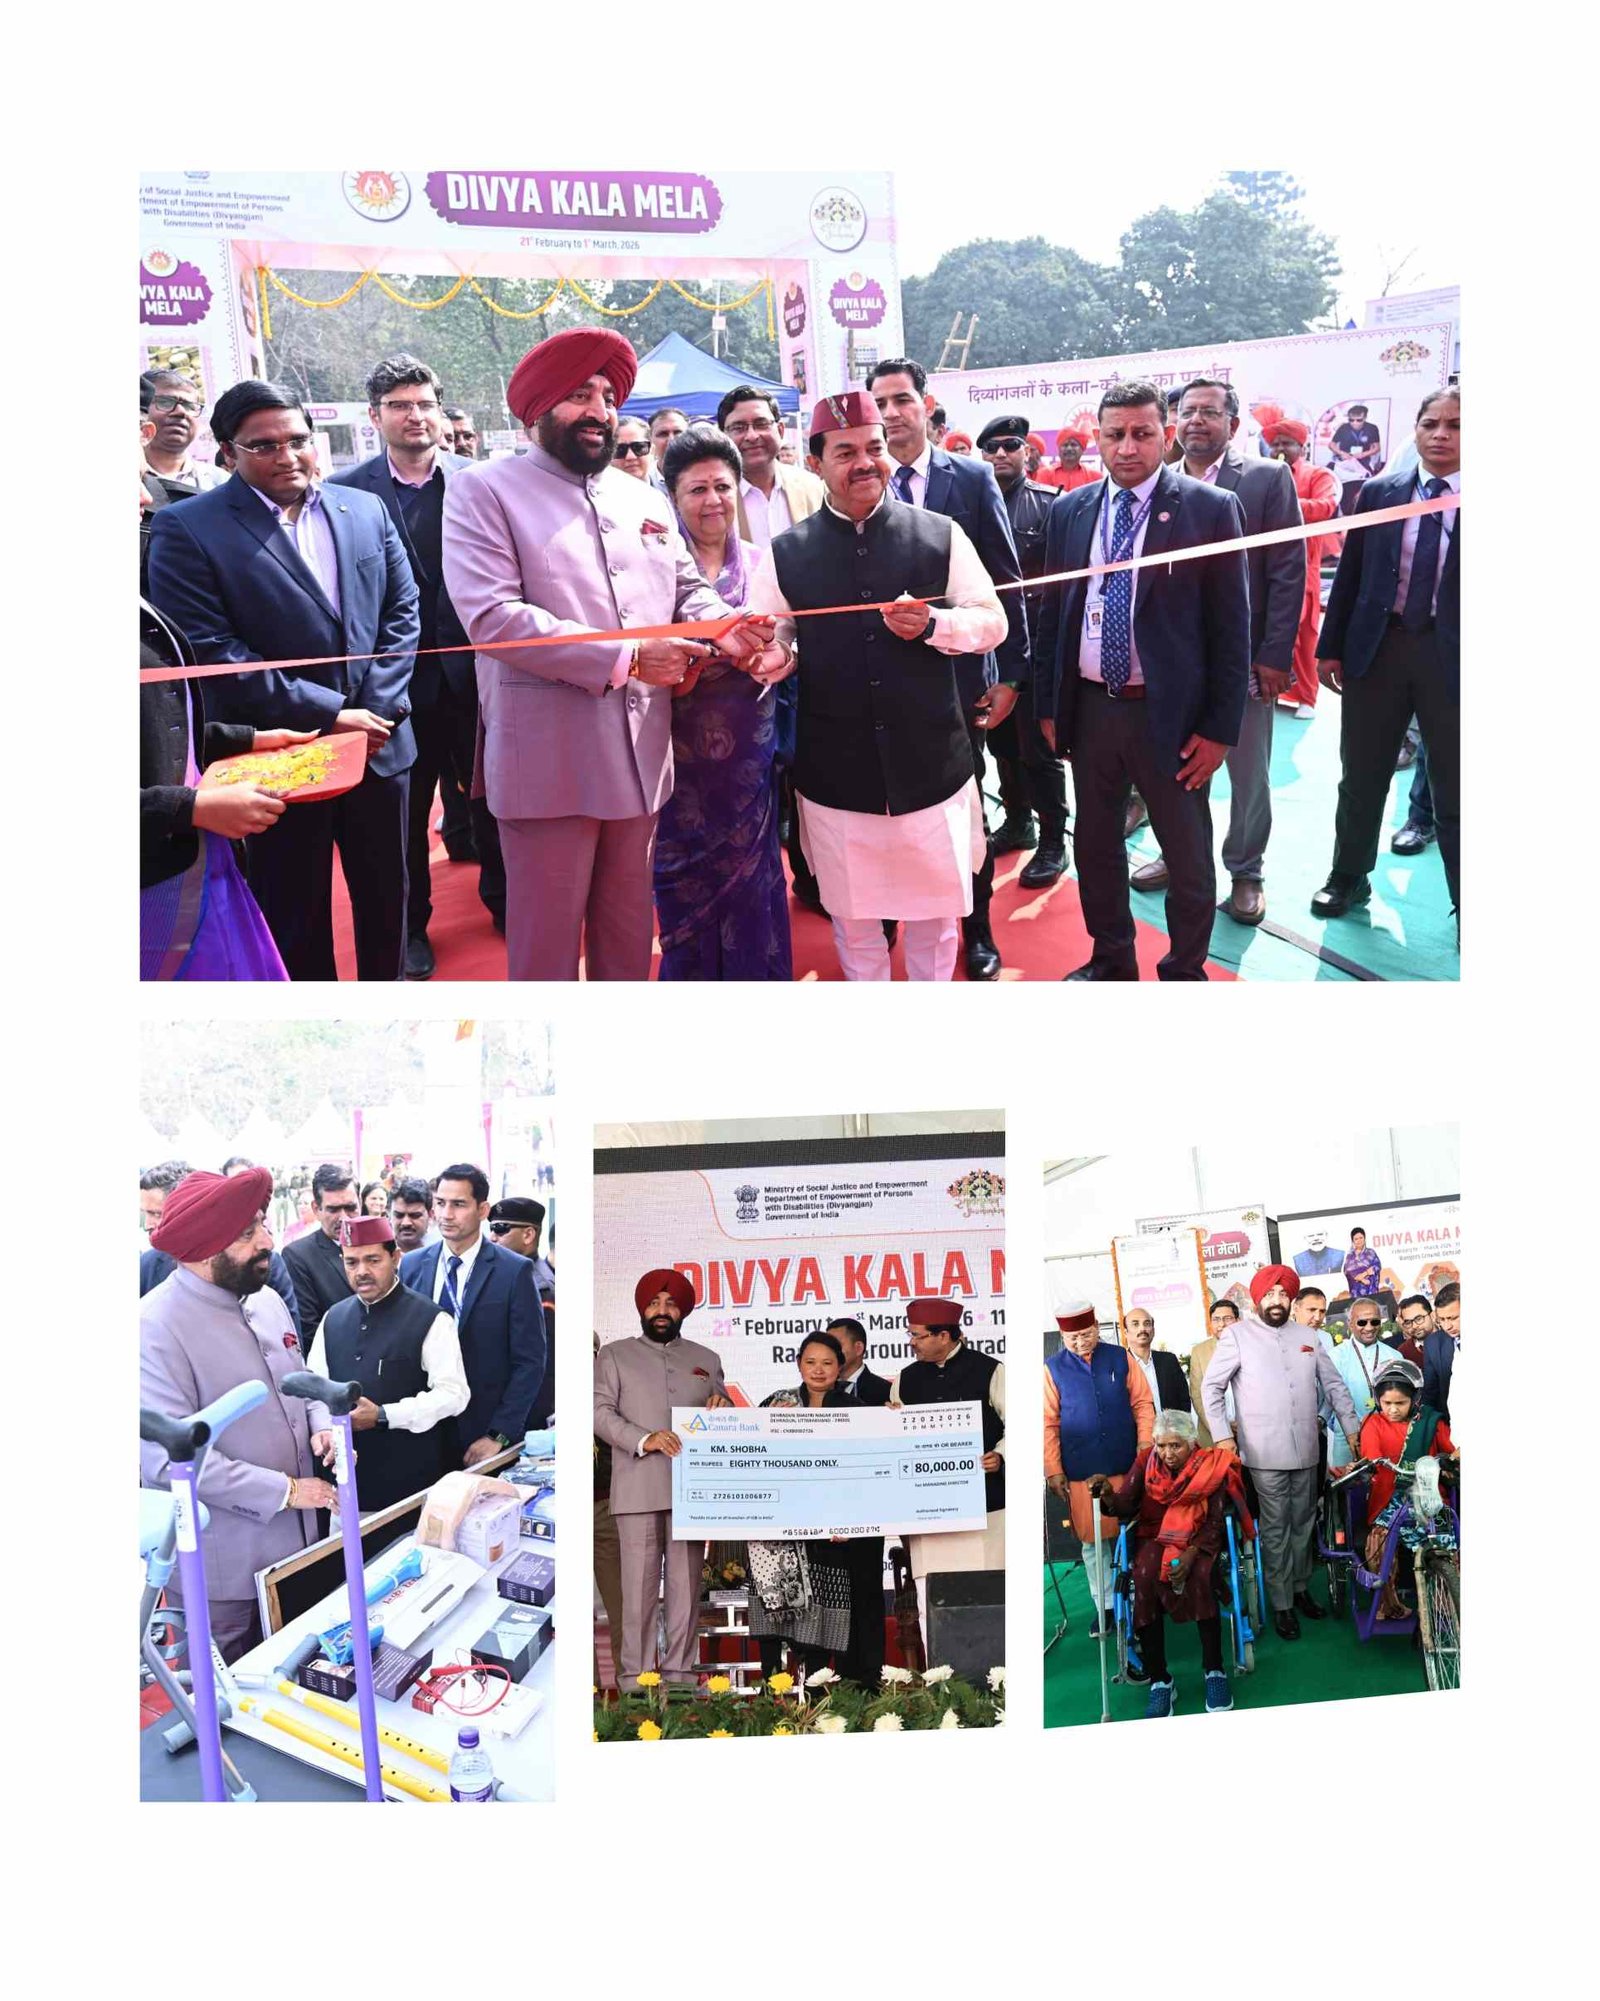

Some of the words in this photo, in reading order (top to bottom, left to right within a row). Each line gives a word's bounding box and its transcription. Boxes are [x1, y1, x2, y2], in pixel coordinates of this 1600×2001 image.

[156, 187, 181, 195] Social
[184, 189, 213, 198] Justice
[216, 191, 231, 199] and
[234, 192, 290, 202] Empowerment
[446, 173, 544, 214] DIVYA
[550, 179, 627, 217] KALA
[634, 184, 709, 219] MELA
[252, 203, 283, 212] Persons
[163, 219, 212, 229] Government
[226, 221, 246, 230] India
[535, 238, 572, 250] February
[574, 239, 582, 249] to
[621, 240, 640, 250] 2026
[169, 285, 205, 301] KALA
[145, 300, 182, 316] MELA
[833, 297, 859, 309] DIVYA
[861, 297, 882, 309] KALA
[845, 310, 868, 321] MELA
[968, 379, 1036, 404] दिव्यांगजनों
[1040, 379, 1053, 398] के
[1152, 373, 1176, 387] का
[764, 1185, 794, 1194] Ministry
[806, 1184, 828, 1192] Social
[831, 1182, 857, 1191] Justice
[875, 1180, 927, 1189] Empowerment
[765, 1194, 807, 1204] Department
[810, 1193, 817, 1201] of
[820, 1192, 872, 1201] Empowerment
[874, 1191, 881, 1199] of
[884, 1190, 913, 1198] Persons
[765, 1203, 781, 1211] with
[784, 1202, 824, 1211] Disabilities
[827, 1200, 873, 1210] (Divyangjan)
[765, 1212, 809, 1221] Government
[821, 1211, 839, 1219] India
[1372, 1231, 1412, 1247] DIVYA
[1417, 1227, 1451, 1243] KALA
[1216, 1241, 1240, 1256] मेला
[673, 1256, 829, 1306] DIVYA
[843, 1250, 976, 1300] KALA
[745, 1317, 822, 1336] February
[708, 1423, 737, 1432] Canara
[740, 1422, 760, 1432] Bank
[710, 1445, 728, 1453] KM.
[730, 1445, 767, 1453] SHOBHA
[729, 1460, 761, 1468] EIGHTY
[763, 1460, 812, 1468] THOUSAND
[815, 1460, 839, 1468] ONLY.
[915, 1460, 974, 1474] 80,000.00
